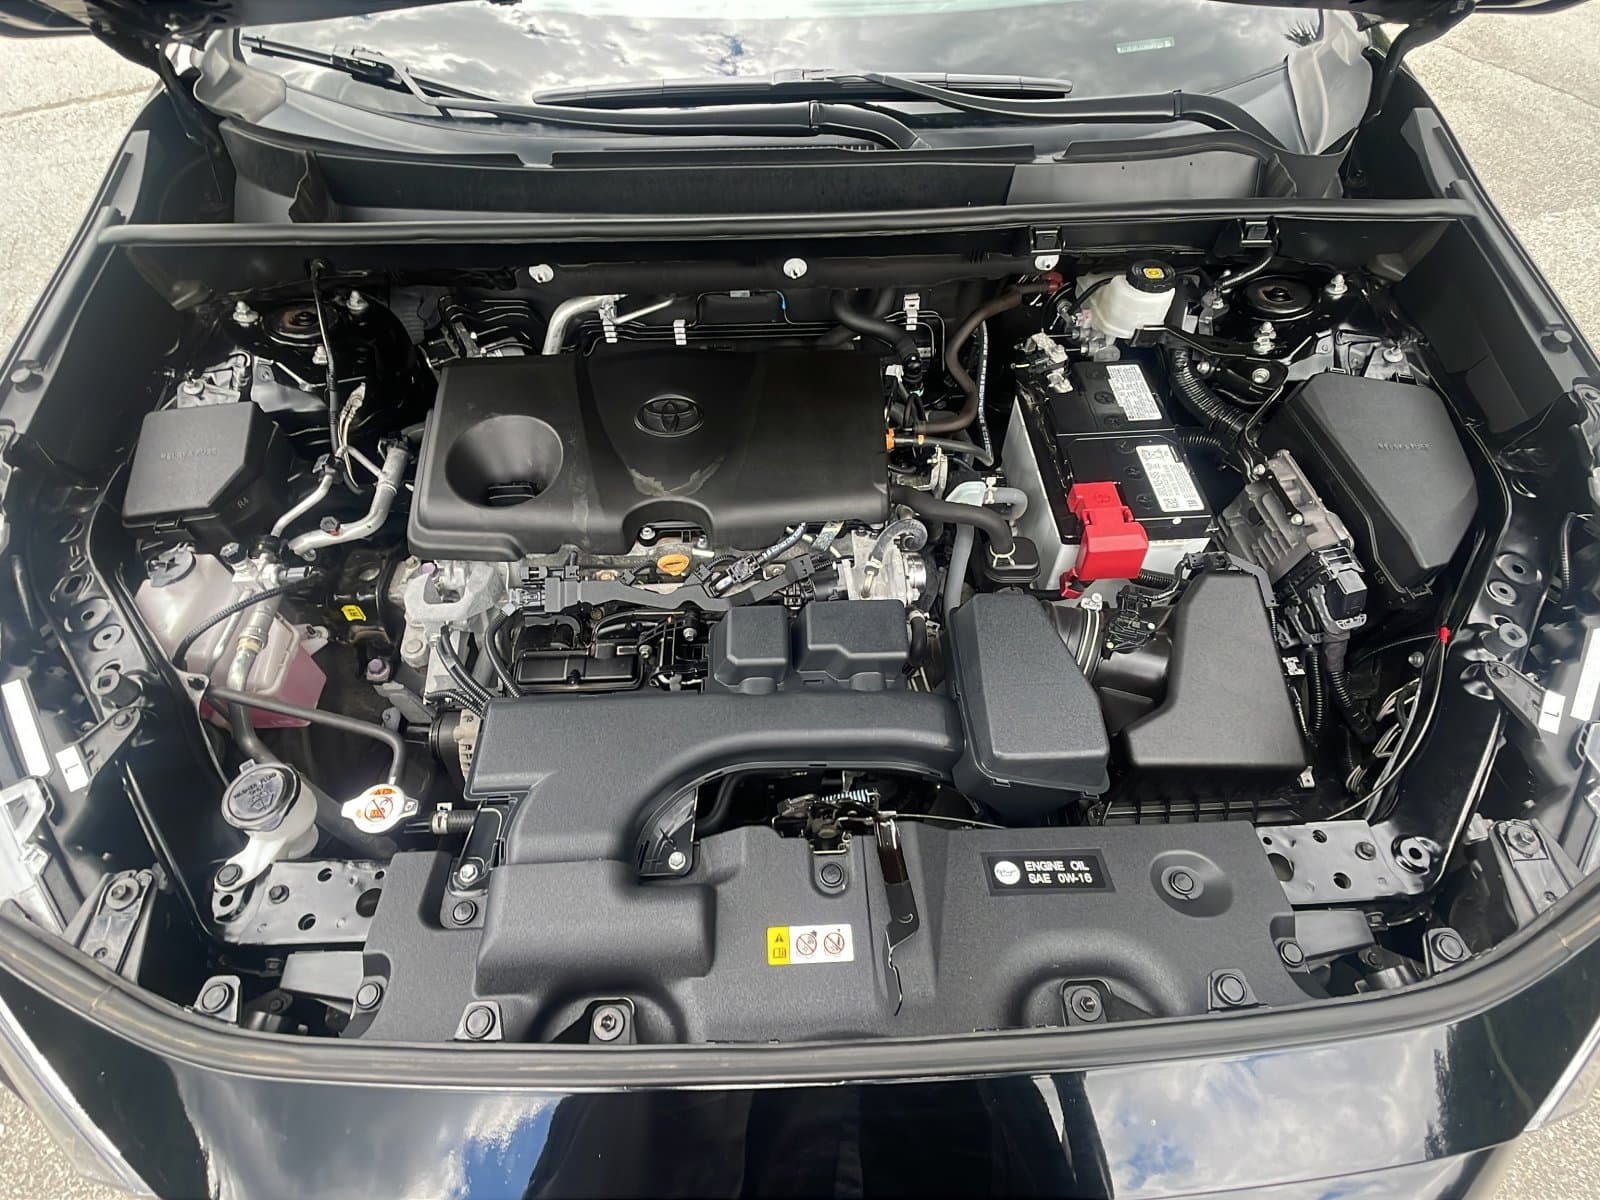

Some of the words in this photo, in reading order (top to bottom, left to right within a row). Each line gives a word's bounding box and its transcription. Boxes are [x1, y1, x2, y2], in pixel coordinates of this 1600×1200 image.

[1023, 860, 1066, 872] ENGINE
[1069, 860, 1090, 872] OIL
[1027, 872, 1053, 884] SAE
[1056, 872, 1093, 884] 0W-16
